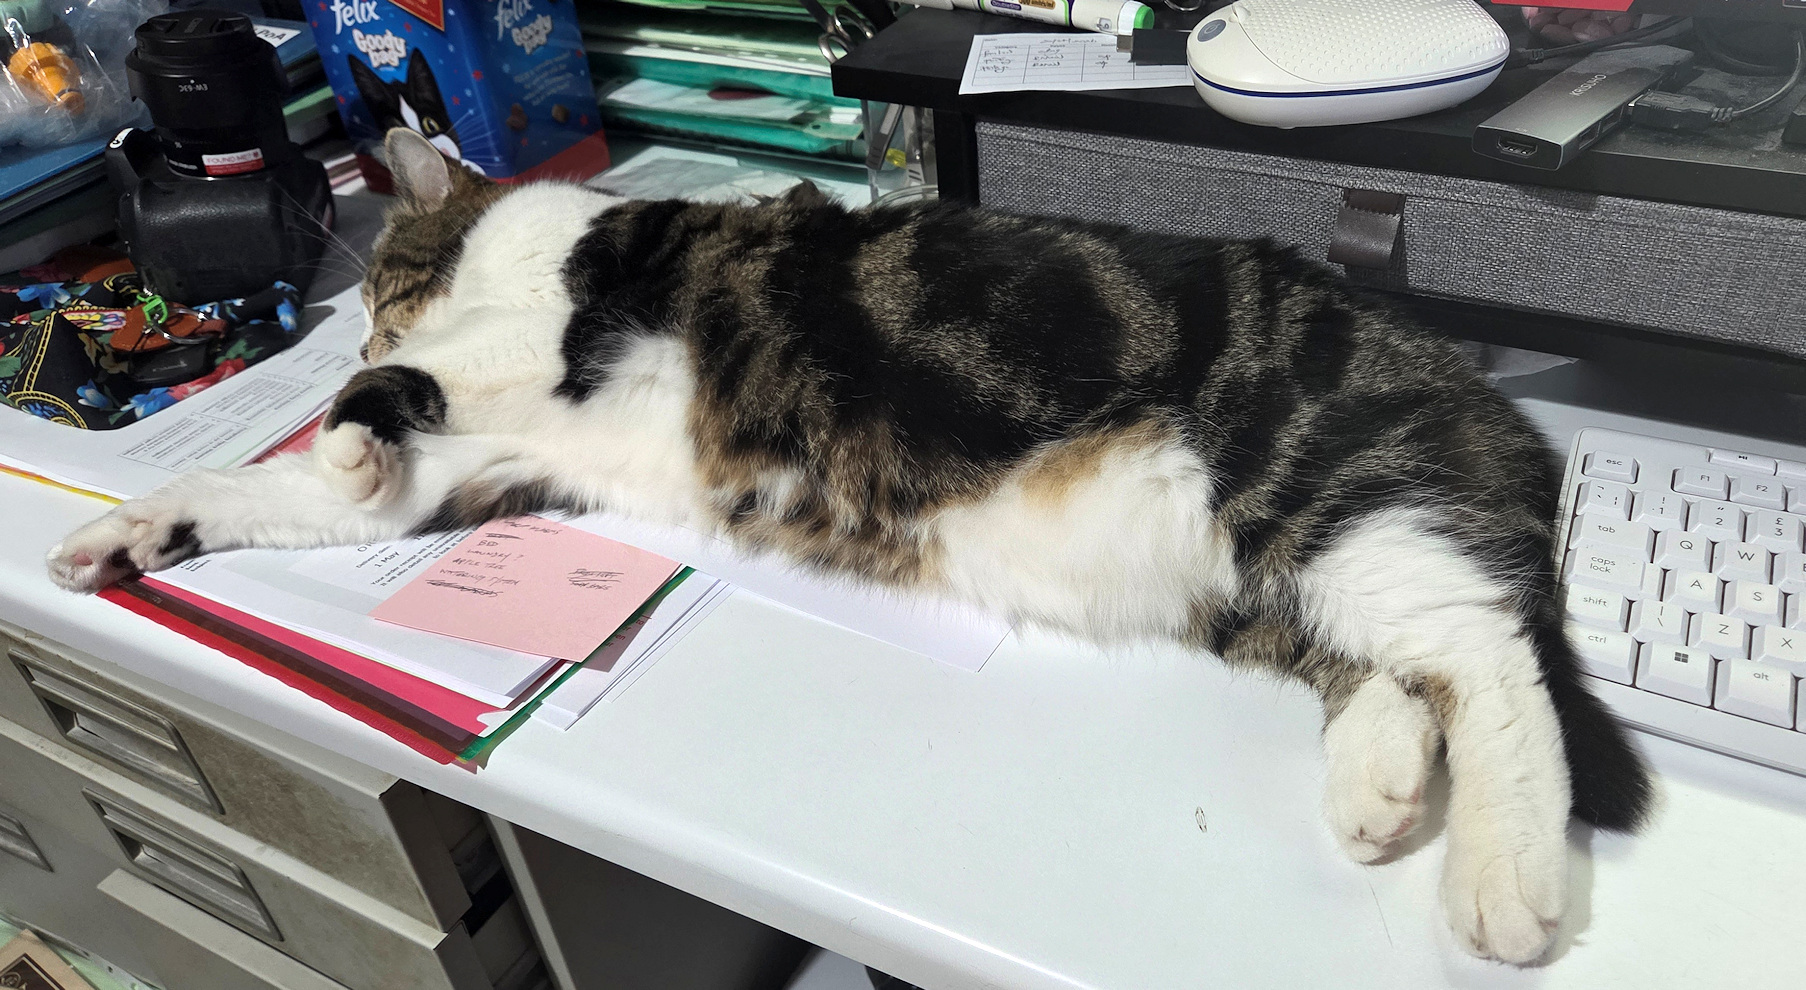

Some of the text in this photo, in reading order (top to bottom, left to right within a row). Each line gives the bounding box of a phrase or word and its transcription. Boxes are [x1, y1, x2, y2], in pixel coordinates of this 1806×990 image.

[352, 28, 407, 59] Goody
[1605, 458, 1623, 466] esc
[1700, 474, 1768, 493] F1 F2
[1658, 507, 1664, 515] 1
[1715, 517, 1723, 526] 2
[1775, 517, 1784, 526] £
[1597, 525, 1616, 534] tab
[1774, 527, 1784, 537] 3
[1679, 540, 1755, 562] Q W
[381, 551, 399, 563] May
[1591, 555, 1616, 567] caps
[452, 557, 508, 571] APPLE TREE
[1590, 562, 1612, 574] lock
[1690, 579, 1763, 602] A S
[1583, 596, 1608, 607] shift
[1587, 635, 1607, 644] ctrl
[1718, 623, 1793, 649] Z X
[1753, 671, 1770, 682] alt
